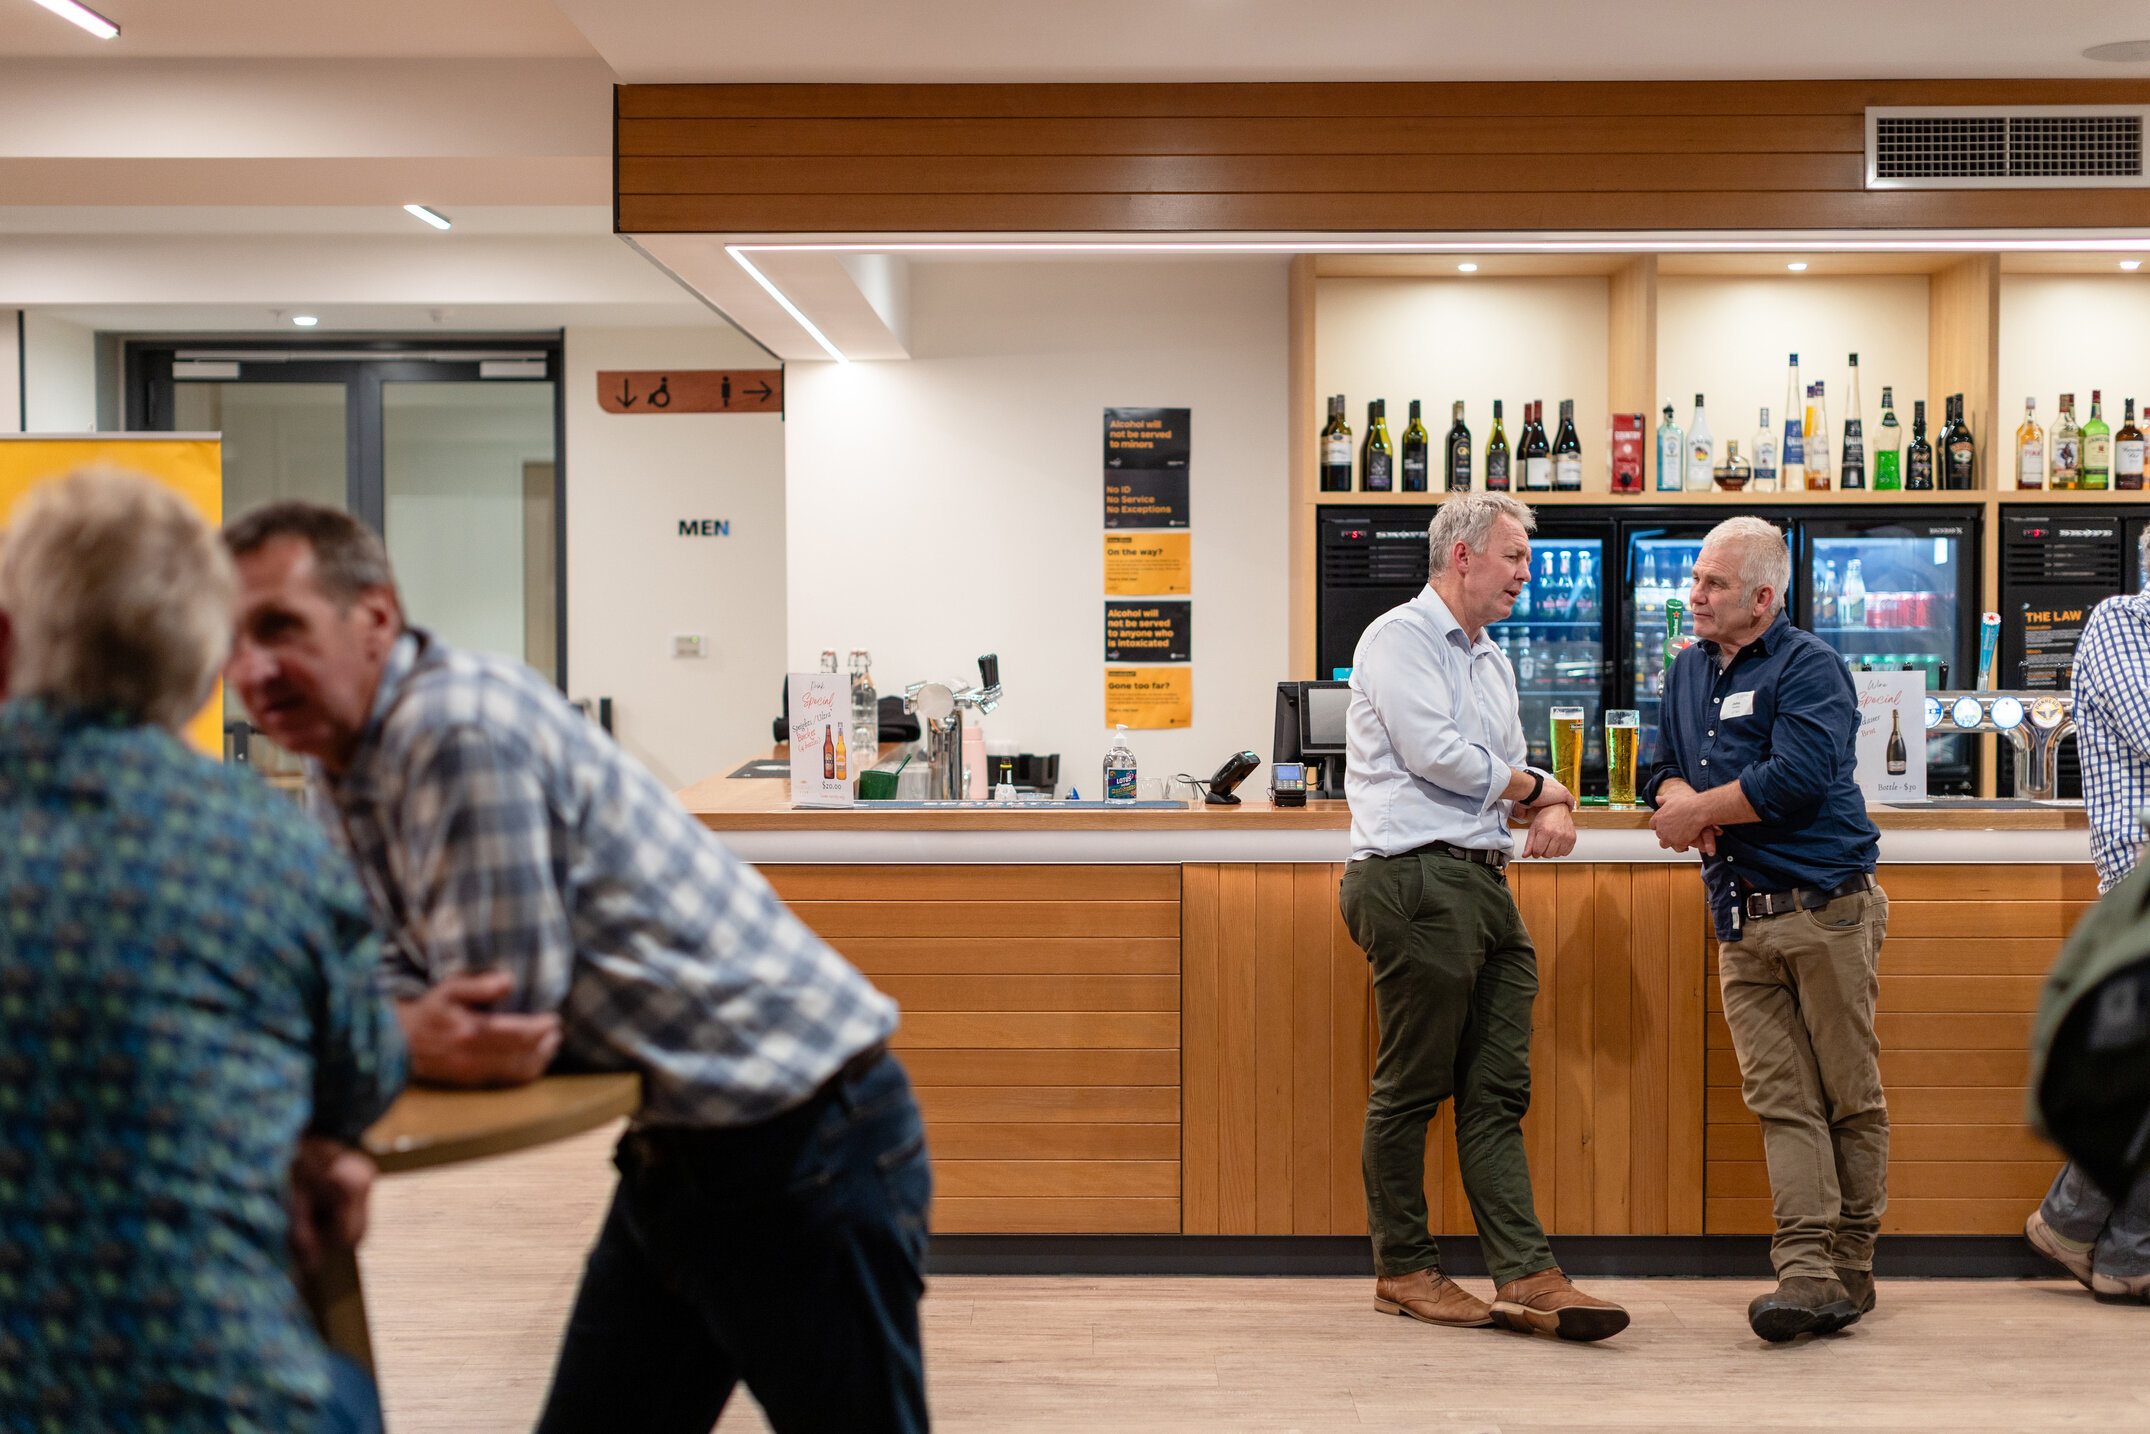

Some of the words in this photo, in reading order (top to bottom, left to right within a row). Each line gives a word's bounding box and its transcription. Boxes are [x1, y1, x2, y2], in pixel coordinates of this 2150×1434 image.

[1110, 420, 1145, 428] Alcohol
[1146, 420, 1162, 428] will
[1110, 430, 1126, 438] not
[1127, 430, 1139, 438] be
[1140, 430, 1172, 438] served
[1109, 440, 1120, 448] to
[1121, 439, 1154, 448] minors
[1121, 505, 1172, 514] Exceptions
[679, 519, 729, 536] MEN
[1140, 548, 1163, 557] way?
[1108, 609, 1141, 617] Alcohol
[1143, 609, 1159, 617] will
[2025, 611, 2051, 623] THE
[2053, 610, 2082, 622] LAW
[1125, 619, 1137, 627] be
[1139, 619, 1171, 627] served
[1108, 629, 1118, 637] to
[1120, 630, 1153, 639] anyone
[1154, 629, 1174, 637] who
[1108, 639, 1116, 647] is
[1118, 639, 1170, 647] intoxicated
[801, 691, 834, 709] Special
[1858, 690, 1902, 708] Special
[822, 780, 842, 790] $20.00
[1878, 781, 1898, 791] Bottle
